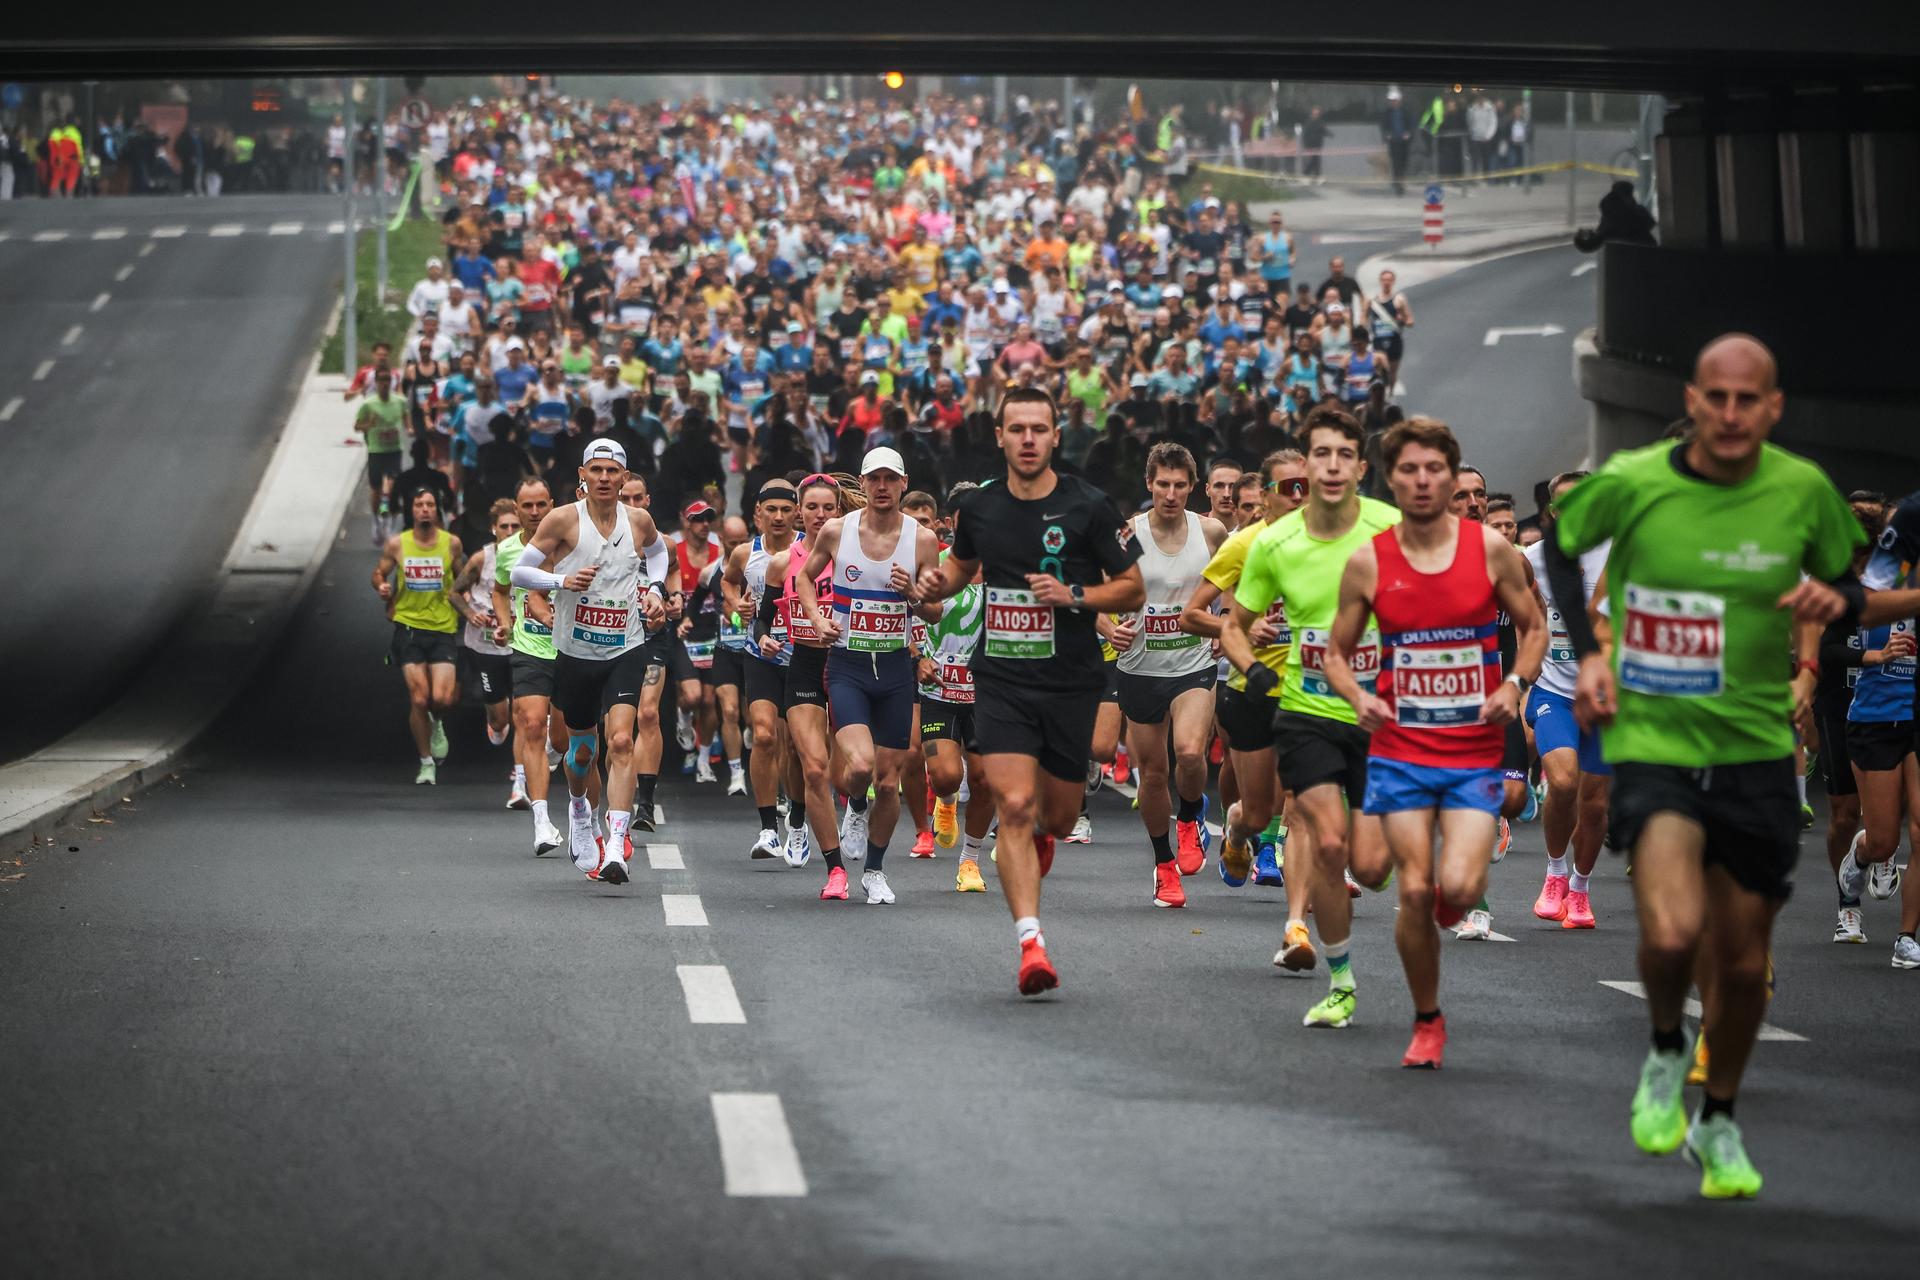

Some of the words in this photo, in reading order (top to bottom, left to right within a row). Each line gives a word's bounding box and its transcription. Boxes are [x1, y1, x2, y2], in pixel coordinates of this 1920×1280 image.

[582, 609, 627, 627] A12379
[857, 615, 868, 630] A
[874, 617, 905, 632] 9574
[995, 608, 1051, 630] A10912
[1153, 619, 1180, 632] A10
[1402, 627, 1476, 644] DULWICH
[950, 668, 959, 682] A
[1408, 671, 1478, 696] A16011
